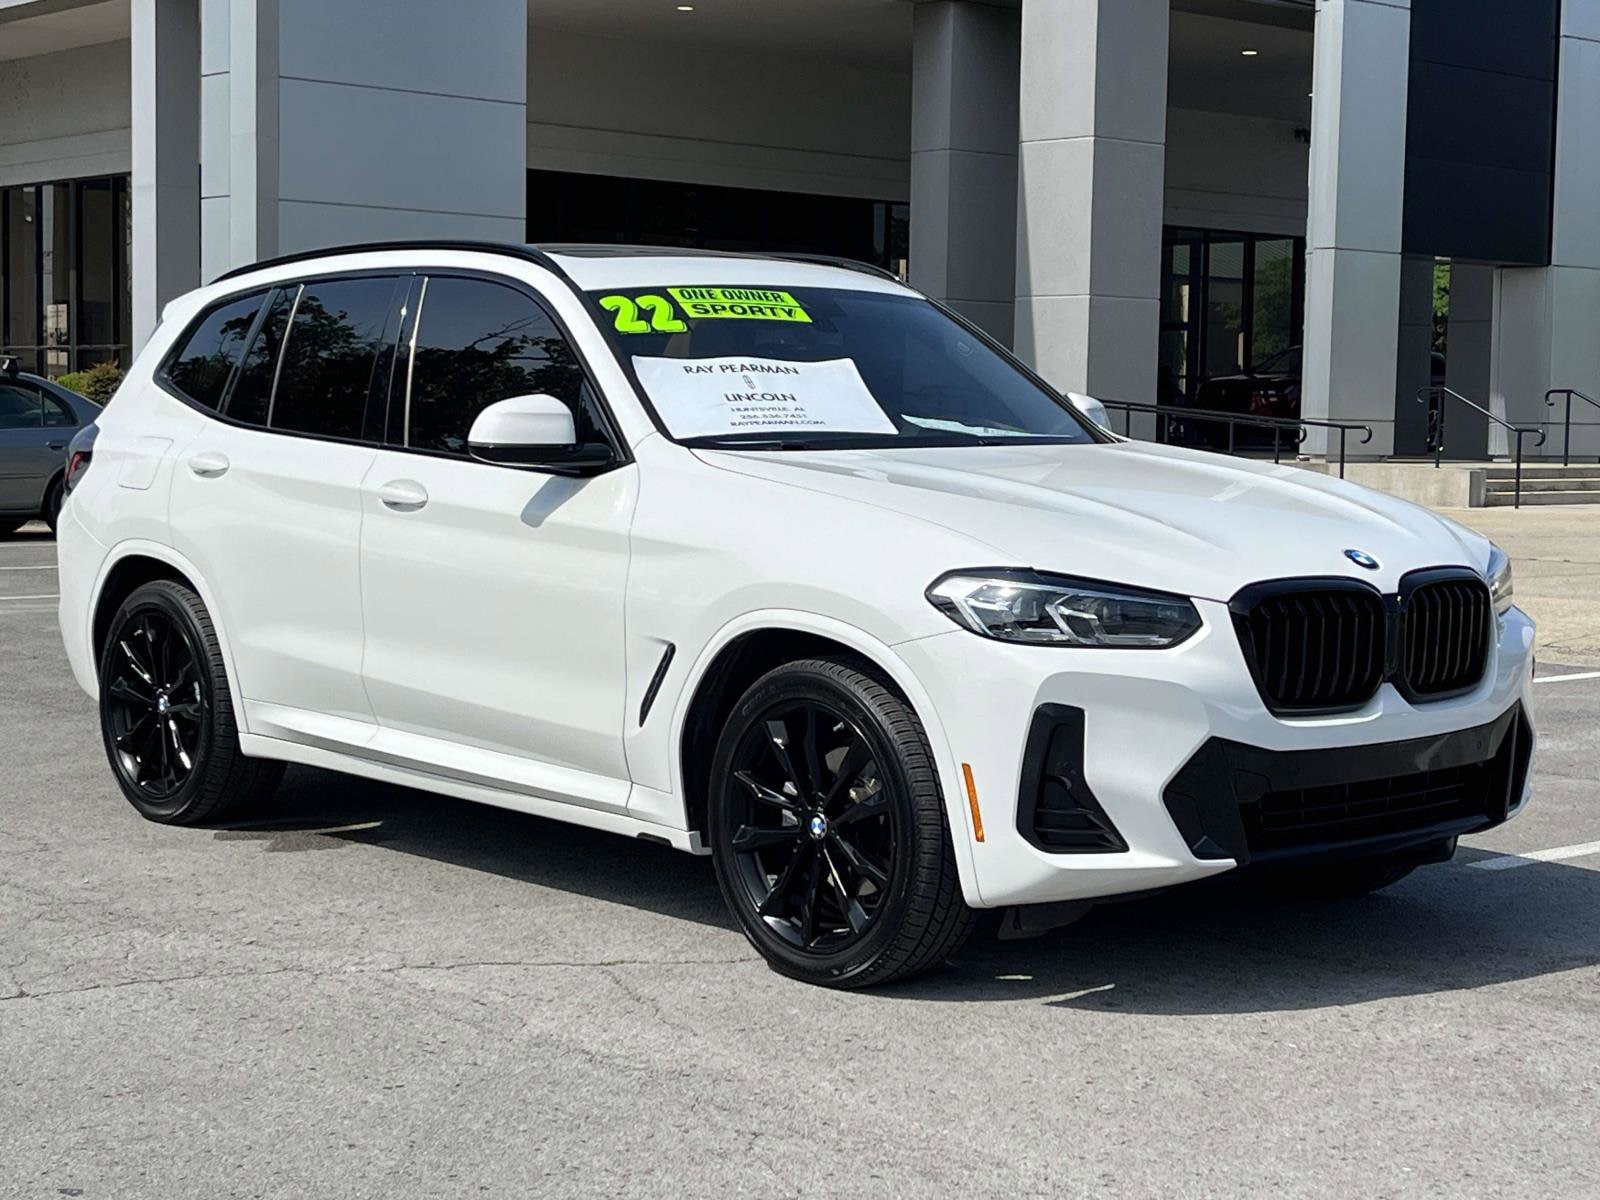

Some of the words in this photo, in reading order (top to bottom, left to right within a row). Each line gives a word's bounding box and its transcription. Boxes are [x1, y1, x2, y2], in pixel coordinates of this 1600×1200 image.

[679, 288, 714, 300] ONE
[721, 289, 784, 303] OWNER
[599, 295, 688, 333] 22
[692, 303, 797, 318] SPORTY
[682, 365, 714, 374] RAY
[719, 363, 800, 375] PEARMAN
[723, 393, 797, 402] LINCOLN
